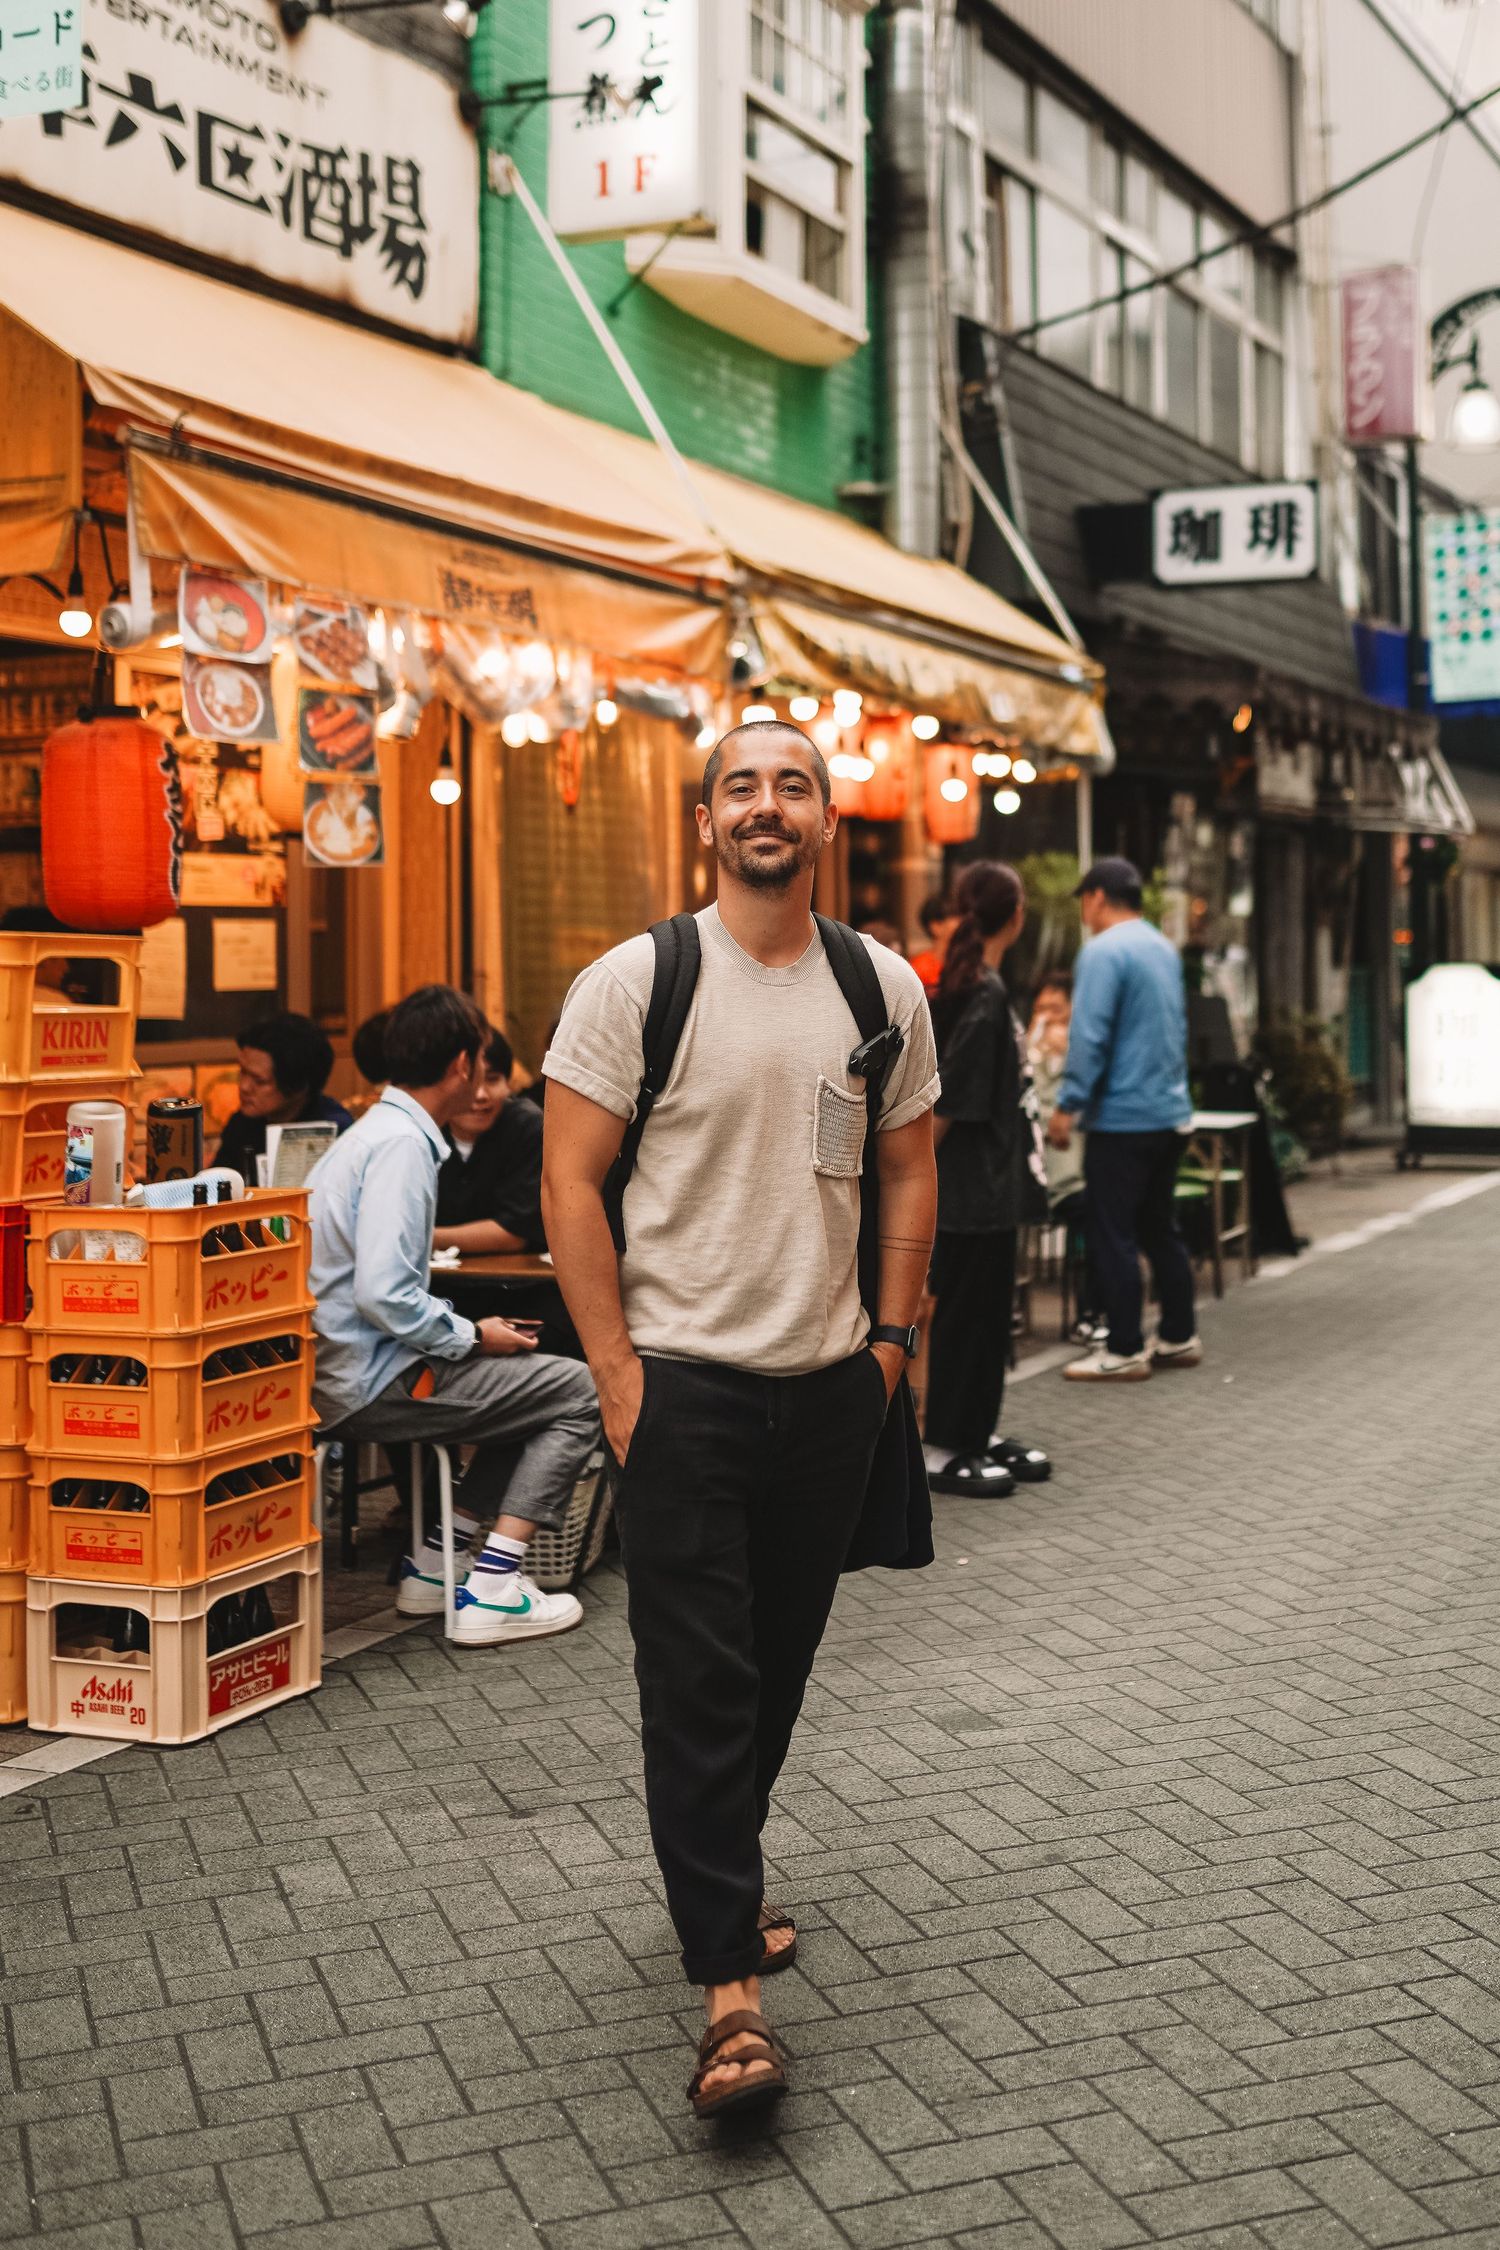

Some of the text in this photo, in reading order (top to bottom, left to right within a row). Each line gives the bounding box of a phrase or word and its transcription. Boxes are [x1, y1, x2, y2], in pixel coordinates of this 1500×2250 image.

[0, 9, 73, 50] ード
[170, 0, 279, 52] OTO
[88, 0, 328, 108] ERTAINMENT
[42, 43, 428, 299] 六区酒場
[1166, 502, 1305, 564] 珈琲
[42, 1020, 110, 1050] KIRIN
[205, 1262, 288, 1311] ホッピー
[206, 1382, 291, 1434] ホッピー
[208, 1502, 293, 1558] ホッピー
[81, 1675, 132, 1703] Asahi
[211, 1643, 289, 1692] アサヒビール
[71, 1700, 146, 1725] 中 ASAHI BEER 20
